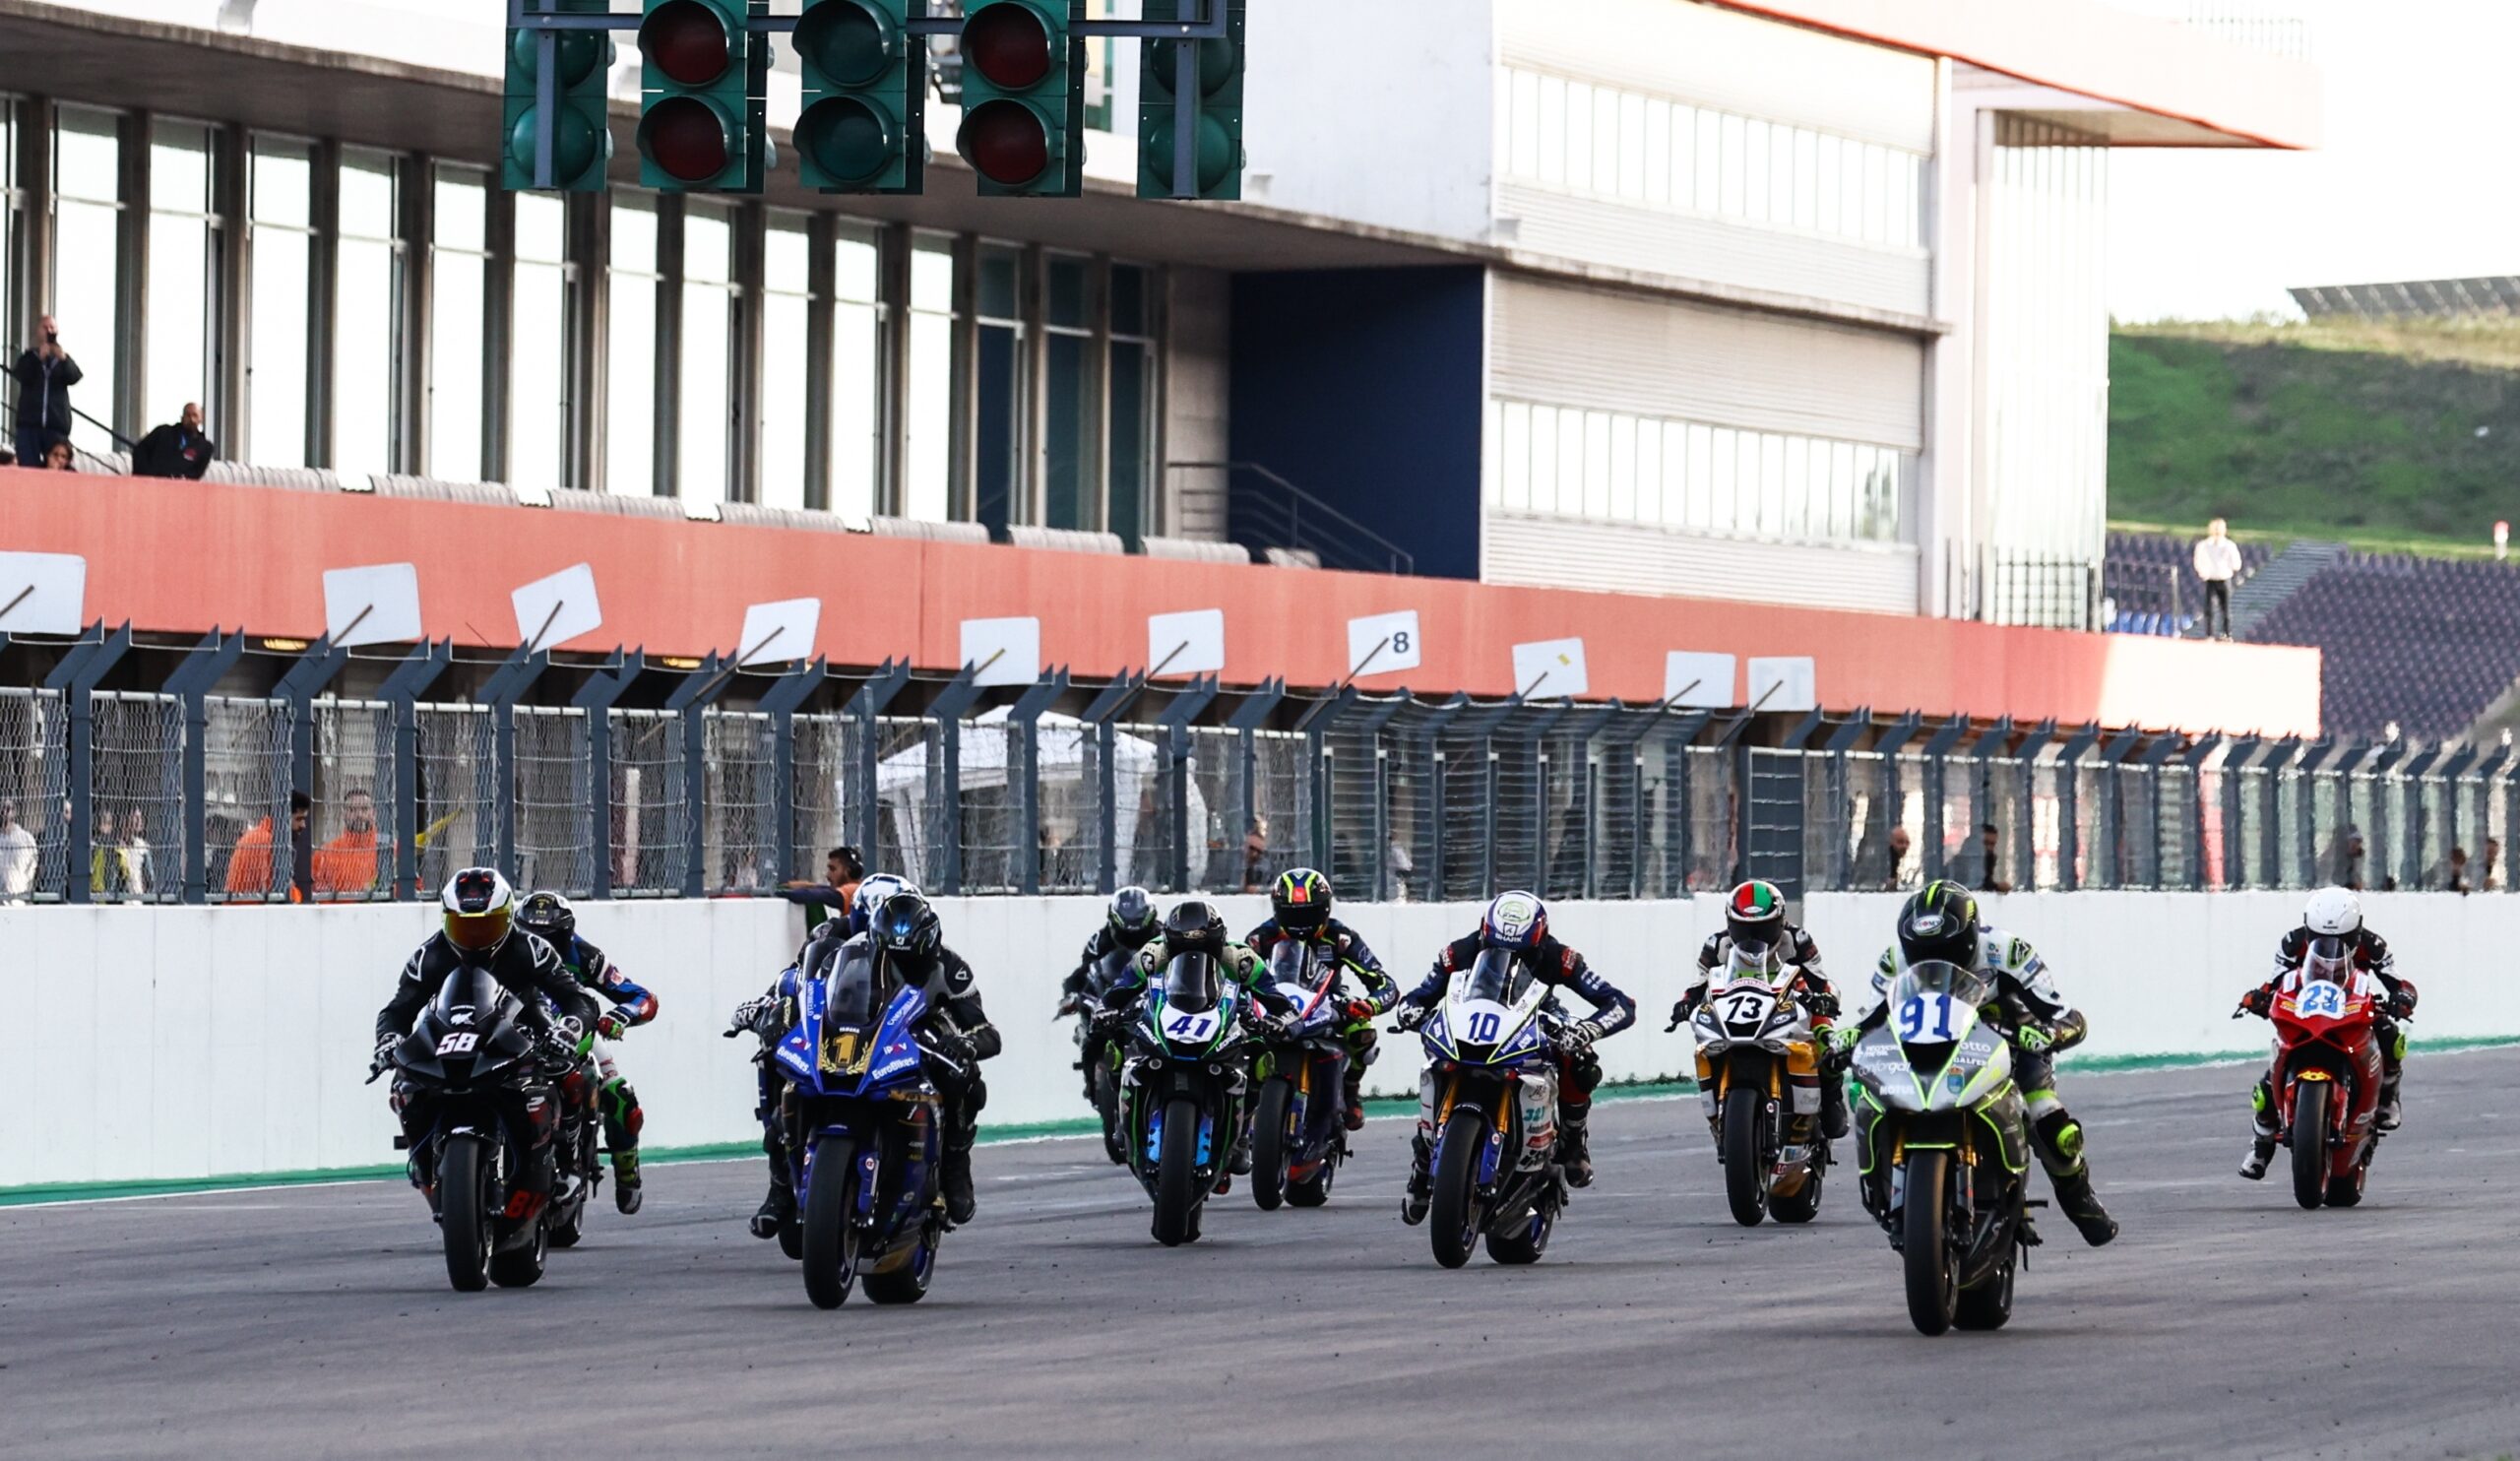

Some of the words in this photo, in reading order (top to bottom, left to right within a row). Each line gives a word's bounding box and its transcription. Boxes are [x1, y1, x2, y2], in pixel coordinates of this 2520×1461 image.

[1393, 631, 1410, 654] 8
[1495, 932, 1523, 943] SHARK
[2303, 985, 2338, 1013] 23
[1166, 1015, 1212, 1038] 41
[1468, 1011, 1501, 1043] 10
[1899, 993, 1952, 1041] 91
[435, 1032, 480, 1056] 58
[834, 1034, 857, 1065] 1
[1960, 1042, 1991, 1052] otto
[777, 1046, 810, 1073] EuroBikes
[872, 1056, 915, 1080] EuroBikes
[1879, 1085, 1916, 1096] MOTUL
